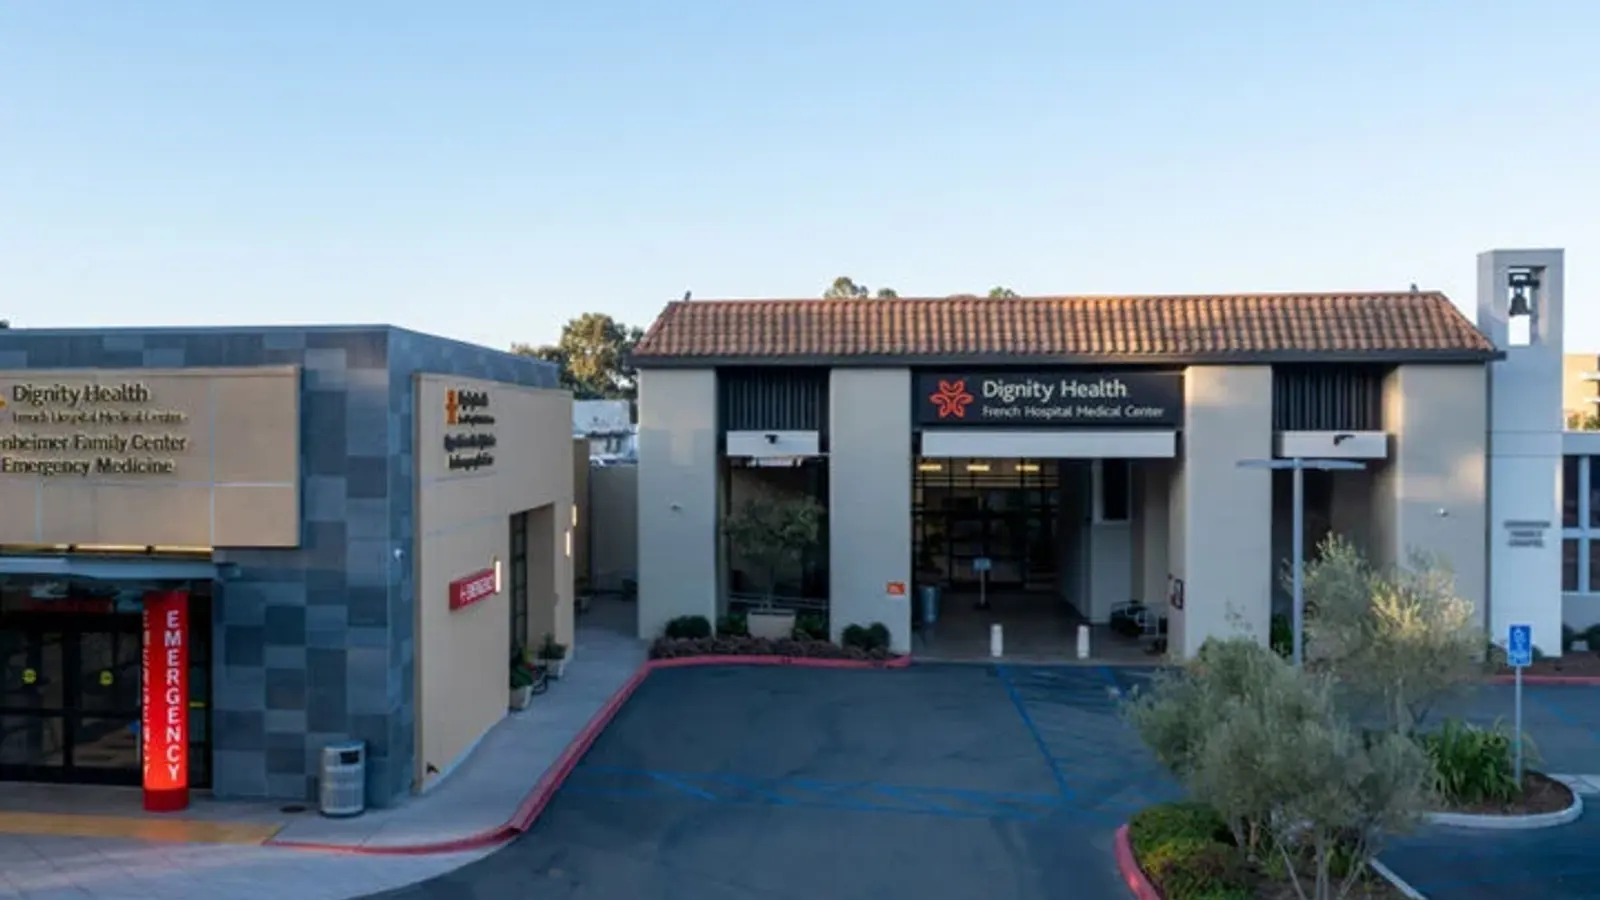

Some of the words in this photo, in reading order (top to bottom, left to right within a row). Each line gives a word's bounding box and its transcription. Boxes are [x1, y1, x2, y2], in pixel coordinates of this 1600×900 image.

[13, 384, 80, 407] Dignity
[84, 383, 148, 402] Health
[982, 379, 1055, 402] Dignity
[1060, 379, 1127, 398] Health
[982, 405, 1021, 417] French
[1025, 405, 1073, 419] Hospital
[1076, 405, 1121, 417] Medical
[1125, 405, 1164, 417] Center
[0, 433, 69, 450] nheimer
[74, 434, 128, 453] Family
[131, 434, 187, 450] Center
[2, 457, 91, 476] Emergency
[97, 457, 174, 474] Medicine
[164, 610, 182, 781] EMERGENCY
